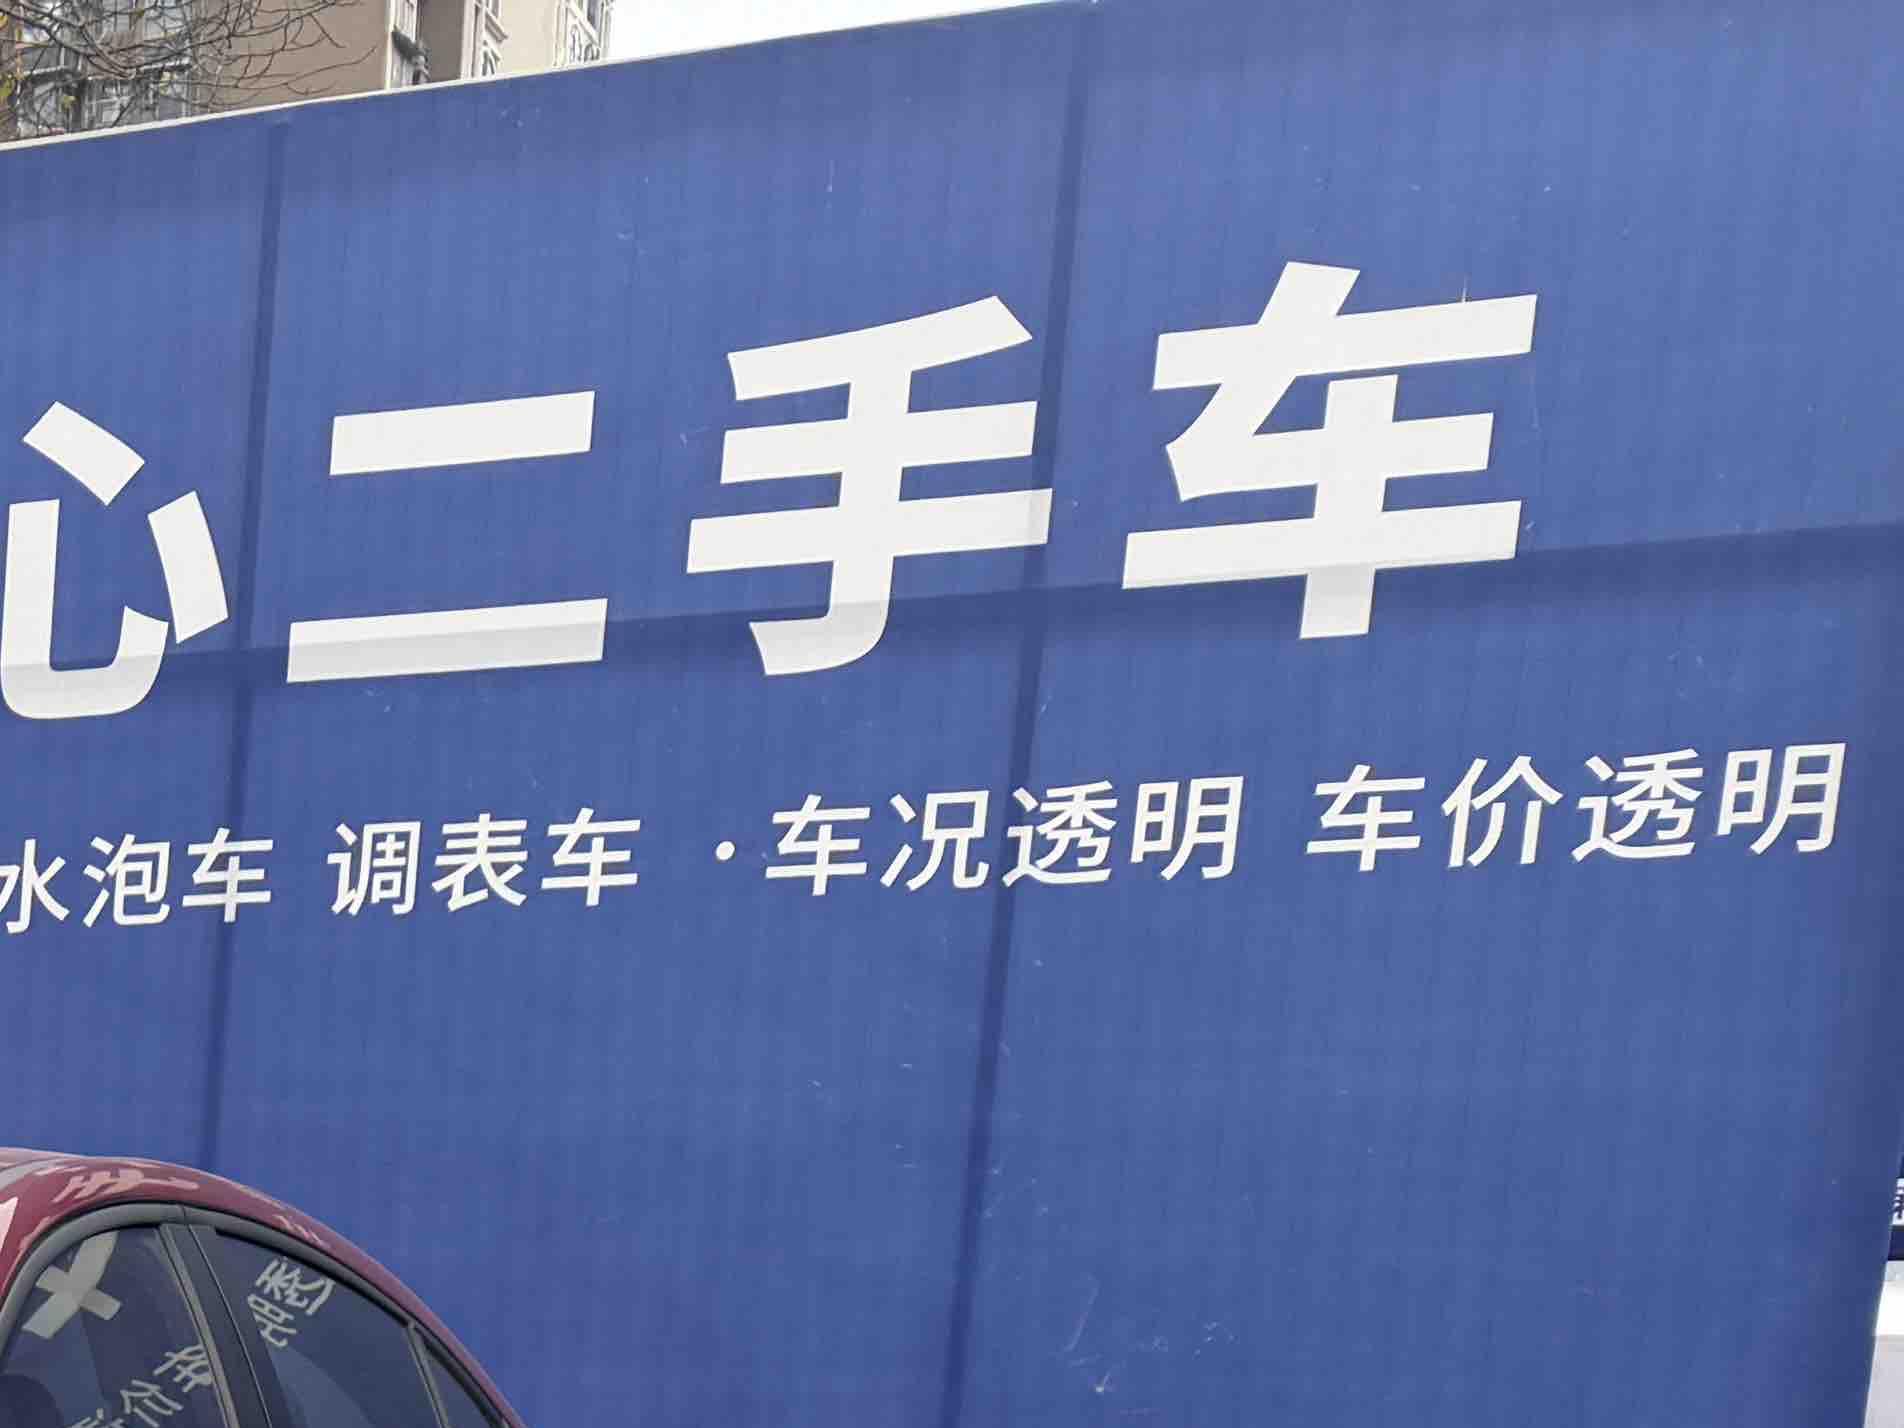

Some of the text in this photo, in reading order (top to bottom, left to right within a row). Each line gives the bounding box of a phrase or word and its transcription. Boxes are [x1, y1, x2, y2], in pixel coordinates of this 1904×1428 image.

[326, 807, 642, 916] 调表车
[1306, 742, 1847, 872] 车价透明
